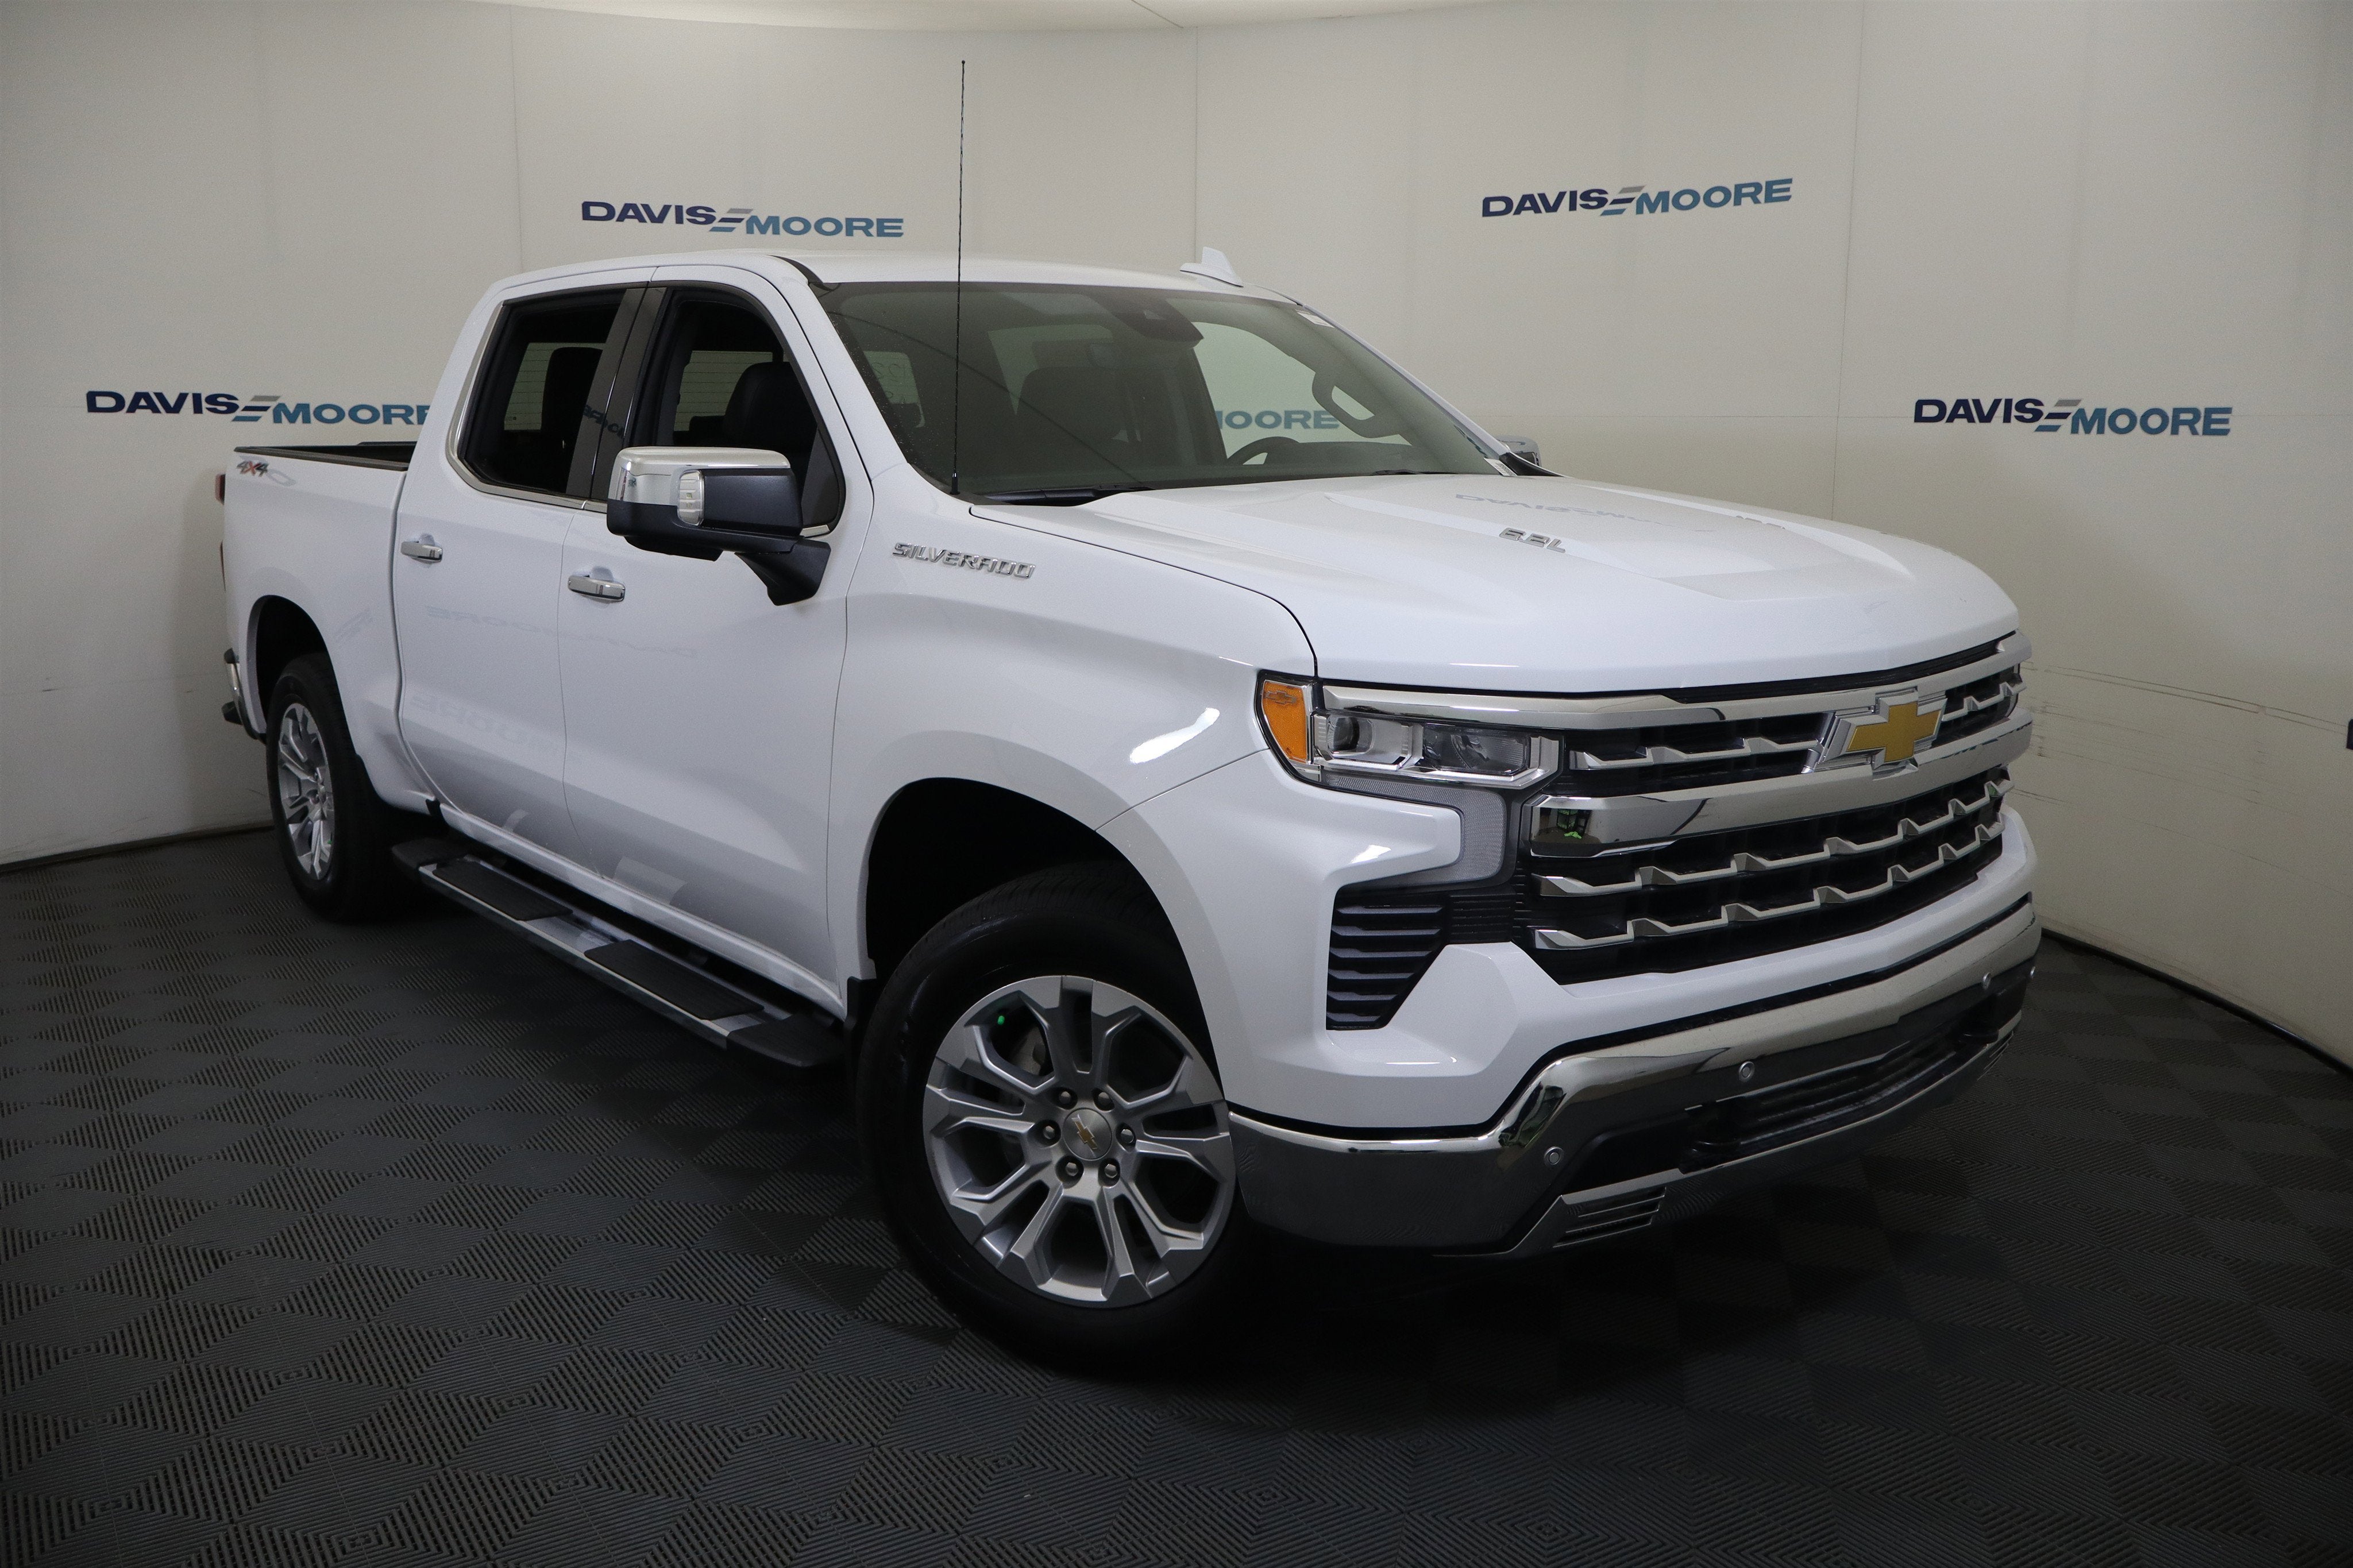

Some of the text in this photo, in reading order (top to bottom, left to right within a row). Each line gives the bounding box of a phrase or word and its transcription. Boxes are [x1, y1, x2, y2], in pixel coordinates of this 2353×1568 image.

[1482, 178, 1793, 218] DAVIS MOORE
[581, 201, 904, 238] DAVIS MOORE
[85, 391, 240, 415] DAVIS
[1914, 397, 2233, 437] DAVIS MOORE
[892, 542, 1036, 579] SILVERADO
